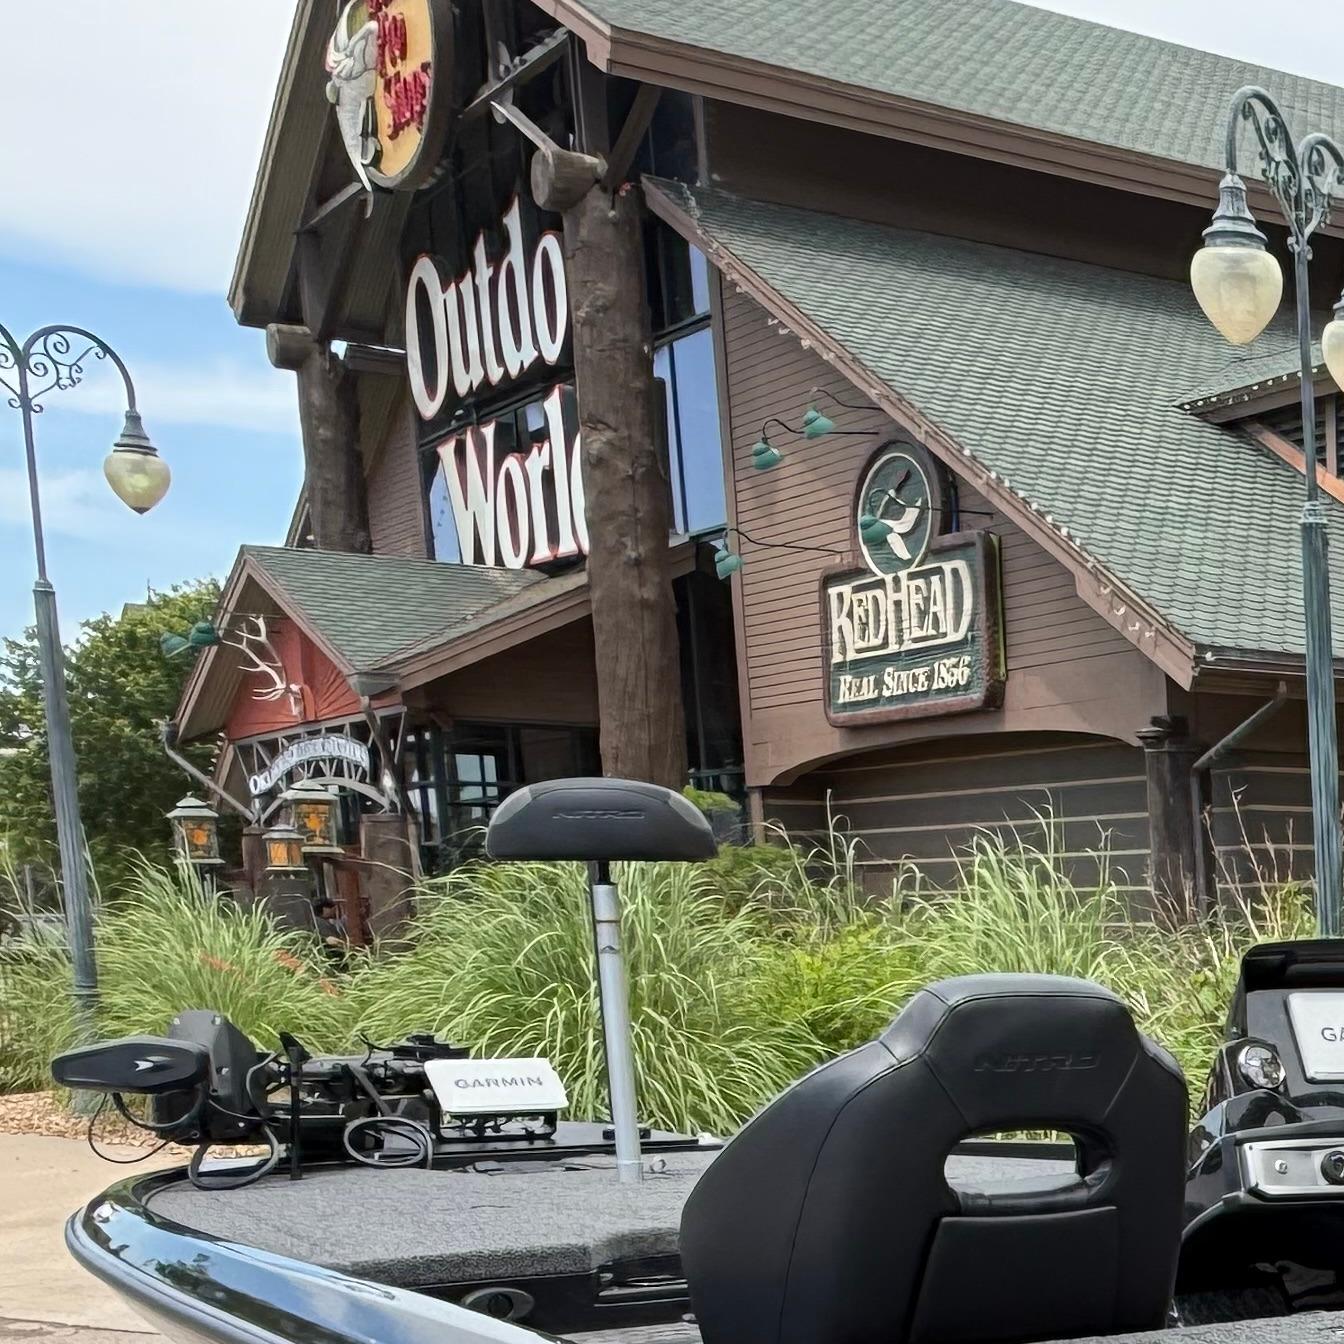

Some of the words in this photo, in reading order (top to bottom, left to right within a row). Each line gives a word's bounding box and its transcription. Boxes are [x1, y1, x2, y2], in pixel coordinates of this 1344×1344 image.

[405, 193, 568, 420] Outdo
[838, 674, 879, 703] REAL
[882, 666, 931, 697] SINCE
[454, 1076, 544, 1089] GARMIN
